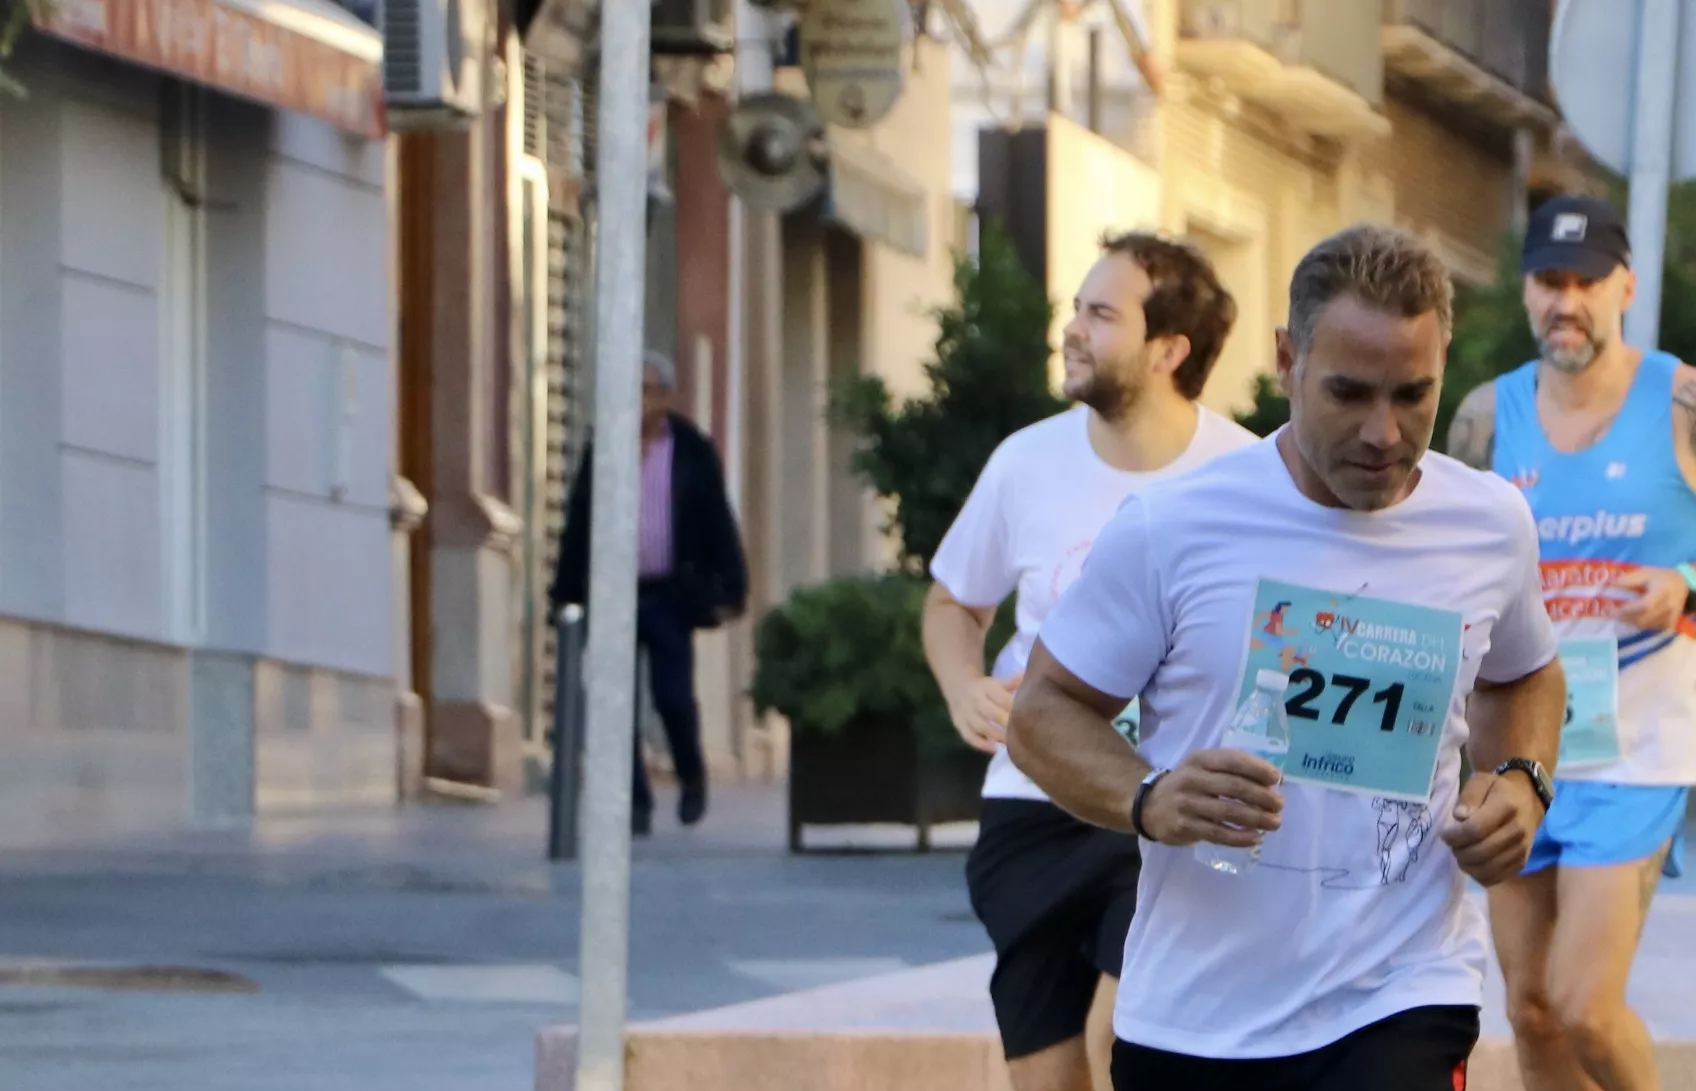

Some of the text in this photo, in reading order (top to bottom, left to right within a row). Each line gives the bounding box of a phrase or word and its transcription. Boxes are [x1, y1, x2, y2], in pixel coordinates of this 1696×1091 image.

[1539, 510, 1647, 545] erplus
[1357, 621, 1416, 644] CARRERA
[1285, 667, 1405, 732] 271
[1302, 752, 1354, 774] Infrico
